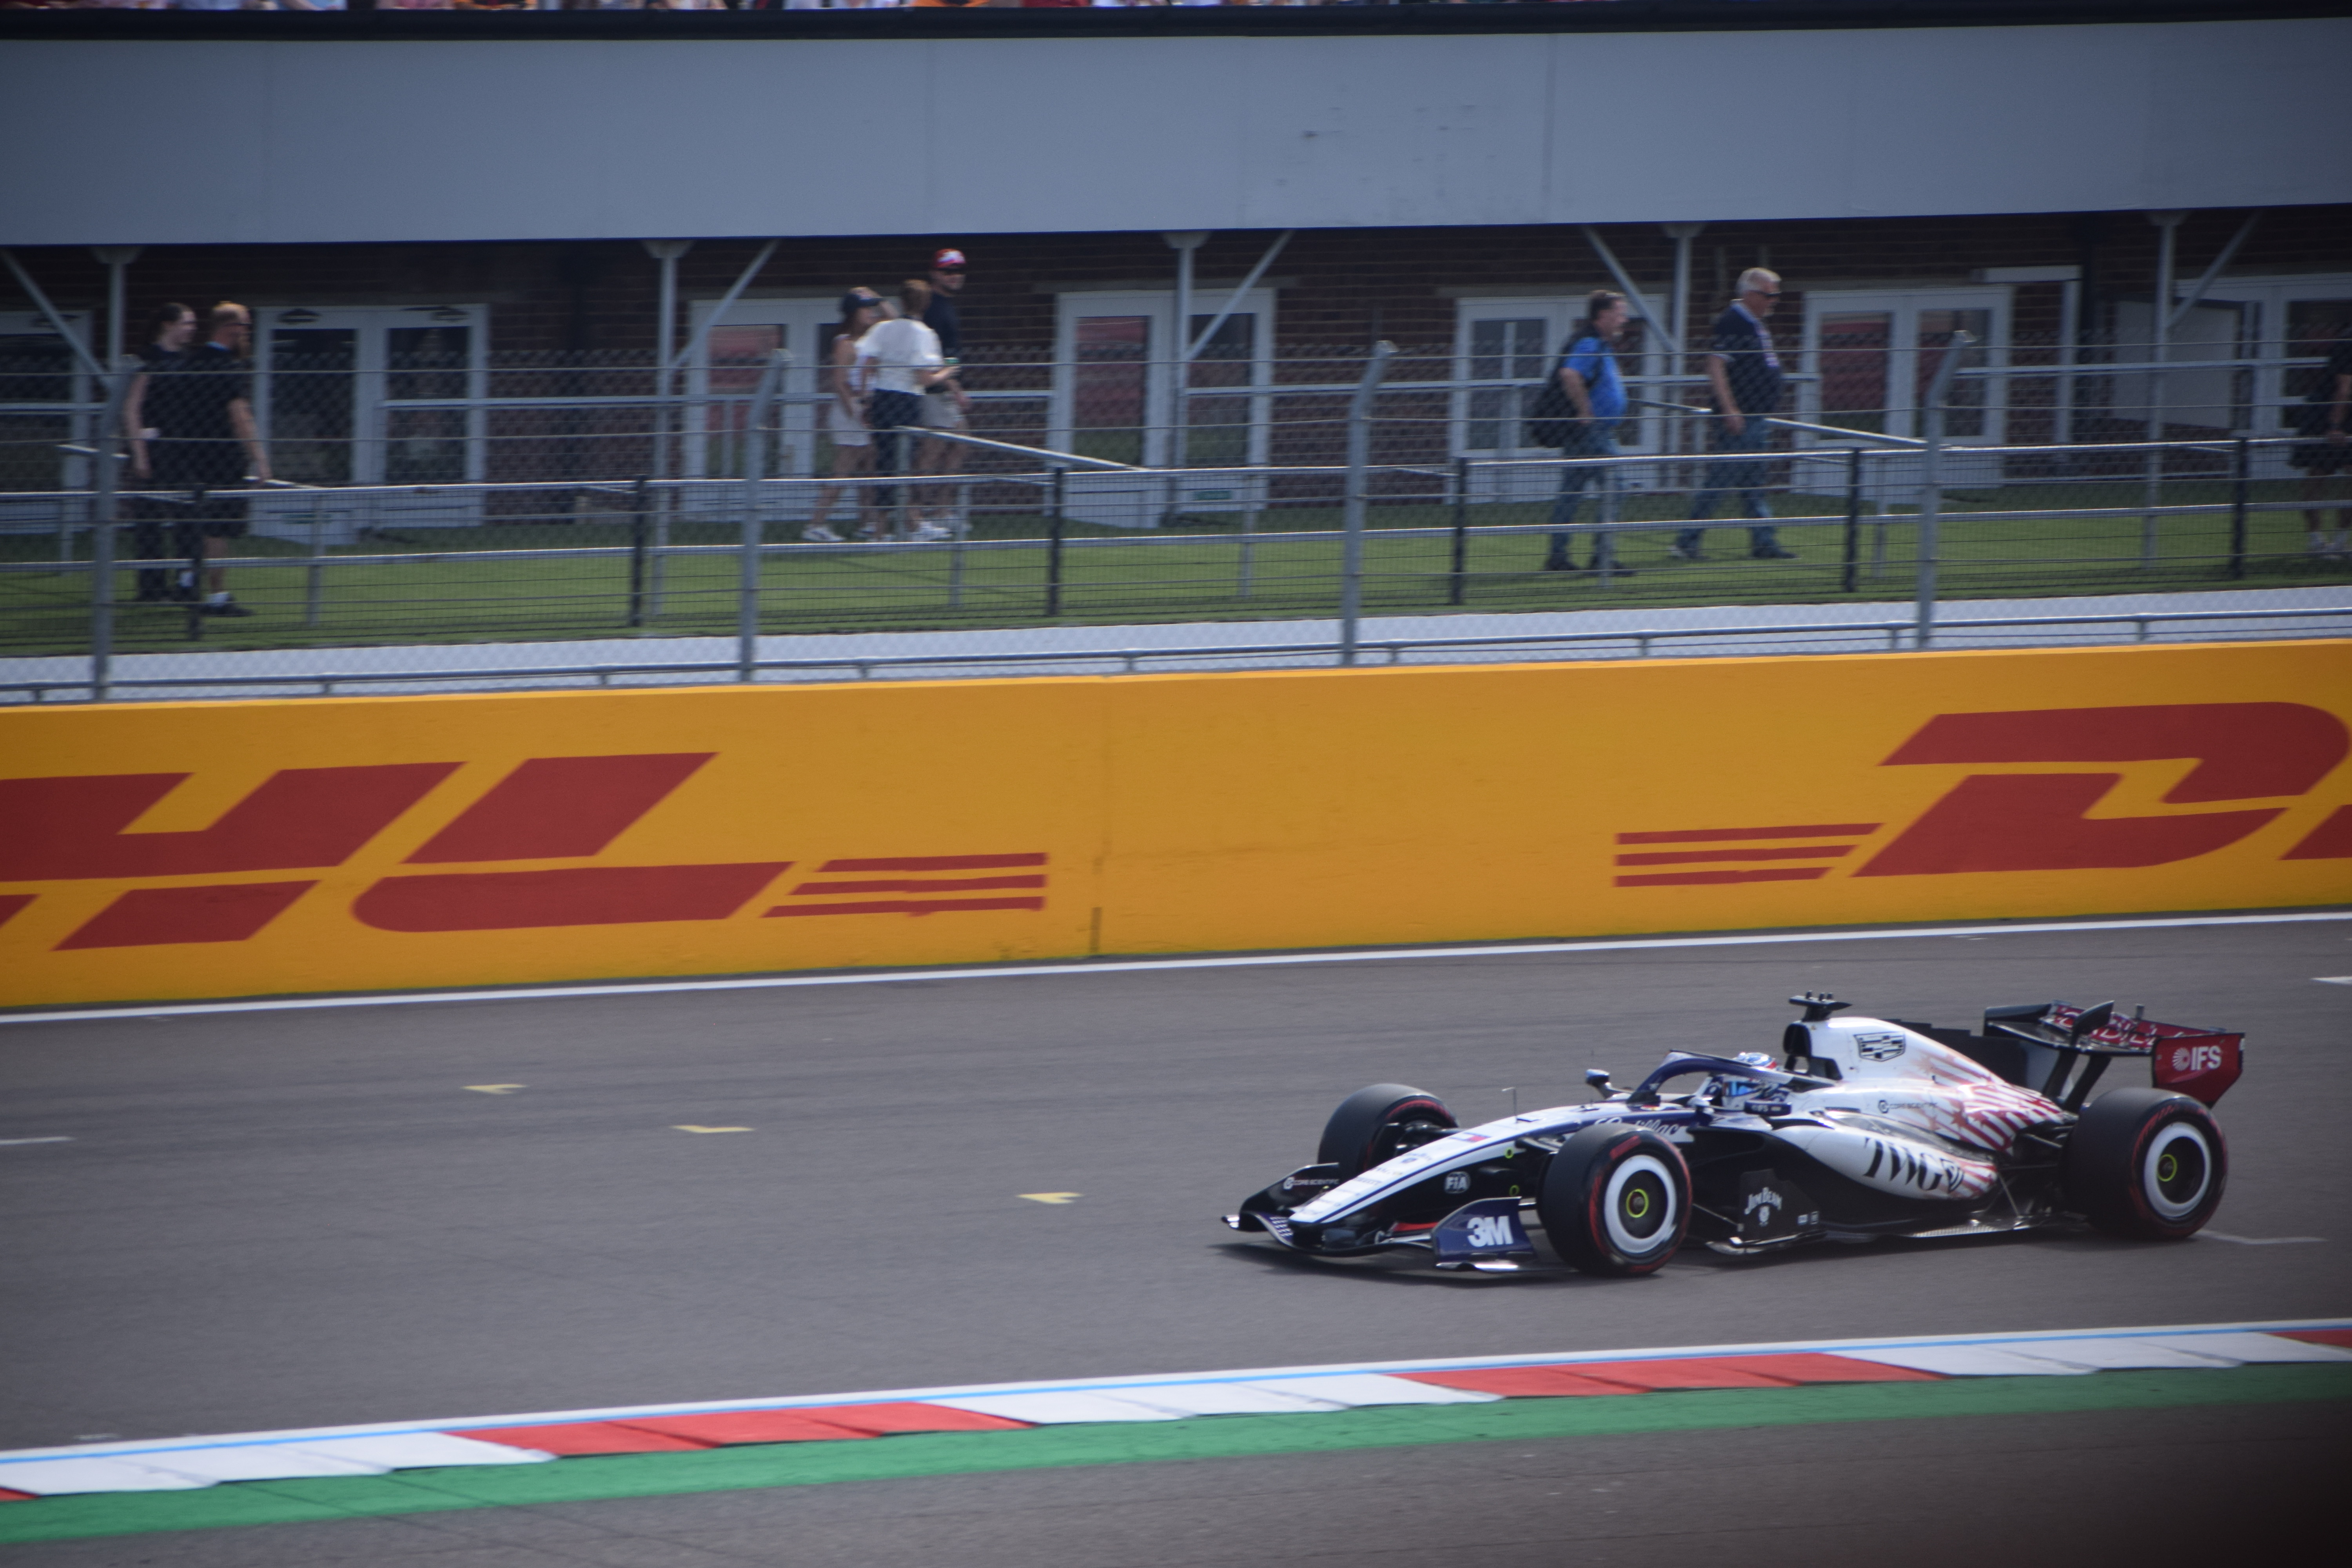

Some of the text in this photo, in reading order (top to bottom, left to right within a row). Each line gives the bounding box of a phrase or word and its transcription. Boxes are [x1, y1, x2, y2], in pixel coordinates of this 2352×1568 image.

[1848, 701, 2352, 878] D
[2191, 1046, 2221, 1071] IFS
[1467, 1215, 1514, 1248] 3M
